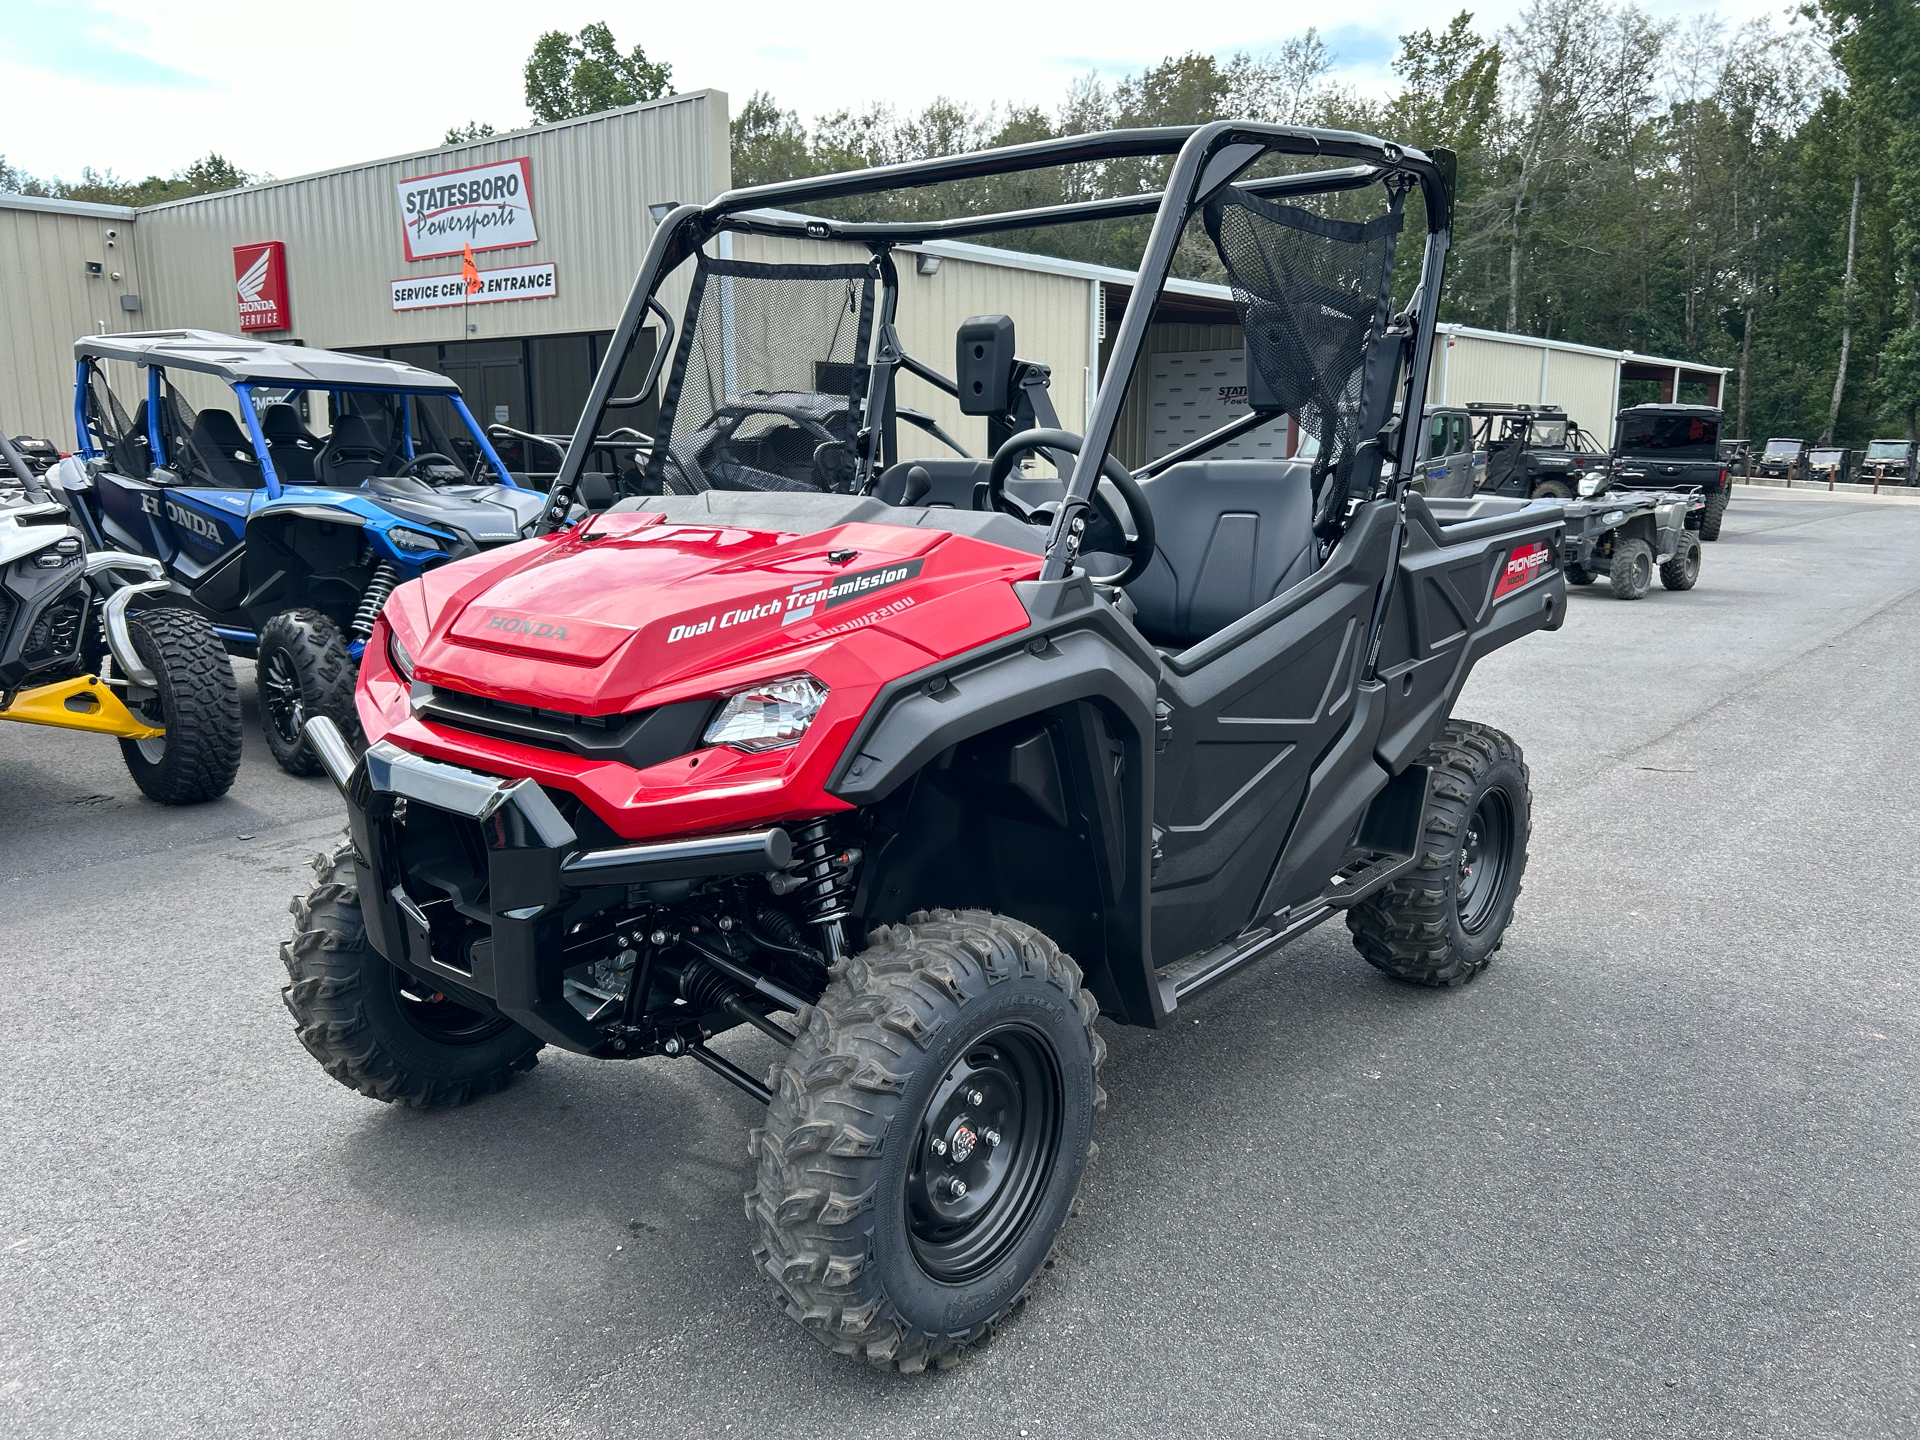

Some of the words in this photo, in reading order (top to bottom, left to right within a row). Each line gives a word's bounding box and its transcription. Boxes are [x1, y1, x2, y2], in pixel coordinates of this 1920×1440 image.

[406, 174, 518, 213] STATESBORO
[416, 201, 515, 239] Powersports
[394, 285, 438, 301] SERVICE
[441, 281, 485, 297] CENTR
[488, 273, 552, 293] ENTRANCE
[238, 300, 277, 312] HONDA
[240, 312, 277, 326] SERVICE
[141, 493, 224, 545] HONDA
[187, 533, 220, 553] TALON
[1508, 548, 1549, 575] PIONEER
[1507, 573, 1525, 586] 1000
[667, 617, 714, 644] Dual
[720, 599, 782, 629] Clutch
[786, 567, 908, 610] Transmission
[486, 616, 567, 641] HONDA
